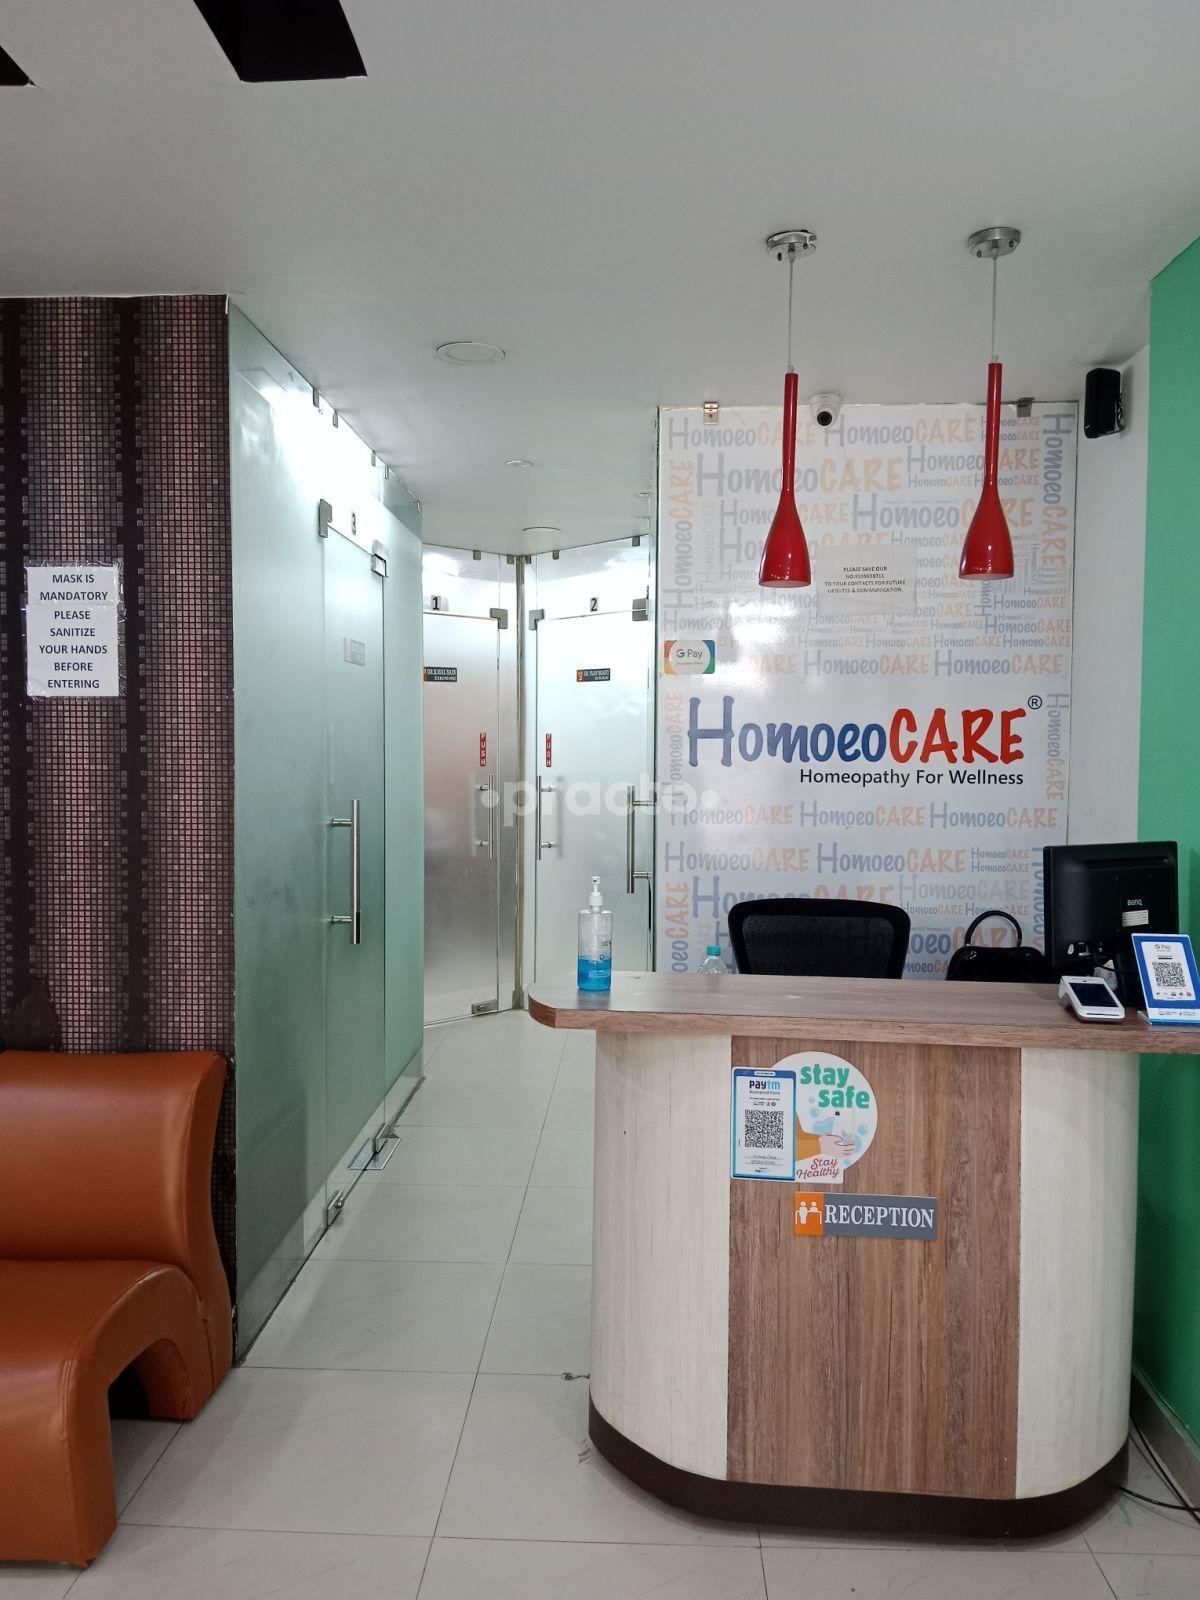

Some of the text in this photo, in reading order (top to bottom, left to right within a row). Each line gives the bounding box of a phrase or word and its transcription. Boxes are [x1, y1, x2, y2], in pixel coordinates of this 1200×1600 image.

[52, 574, 95, 583] MASK IS
[40, 591, 108, 601] MANDATORY
[433, 597, 439, 610] 1
[590, 597, 598, 611] 2
[54, 611, 90, 619] PLEASE
[50, 628, 95, 636] SANITIZE
[39, 645, 107, 654] YOUR HANDS
[687, 649, 703, 659] Pay
[54, 662, 93, 671] BEFORE
[47, 680, 100, 688] ENTERING
[800, 769, 1024, 788] Homeopathy For Wellness
[800, 1063, 849, 1088] stay
[818, 1086, 869, 1109] safe
[811, 1158, 838, 1170] Stay
[796, 1166, 840, 1179] Healthy
[824, 1204, 935, 1229] RECEPTION
